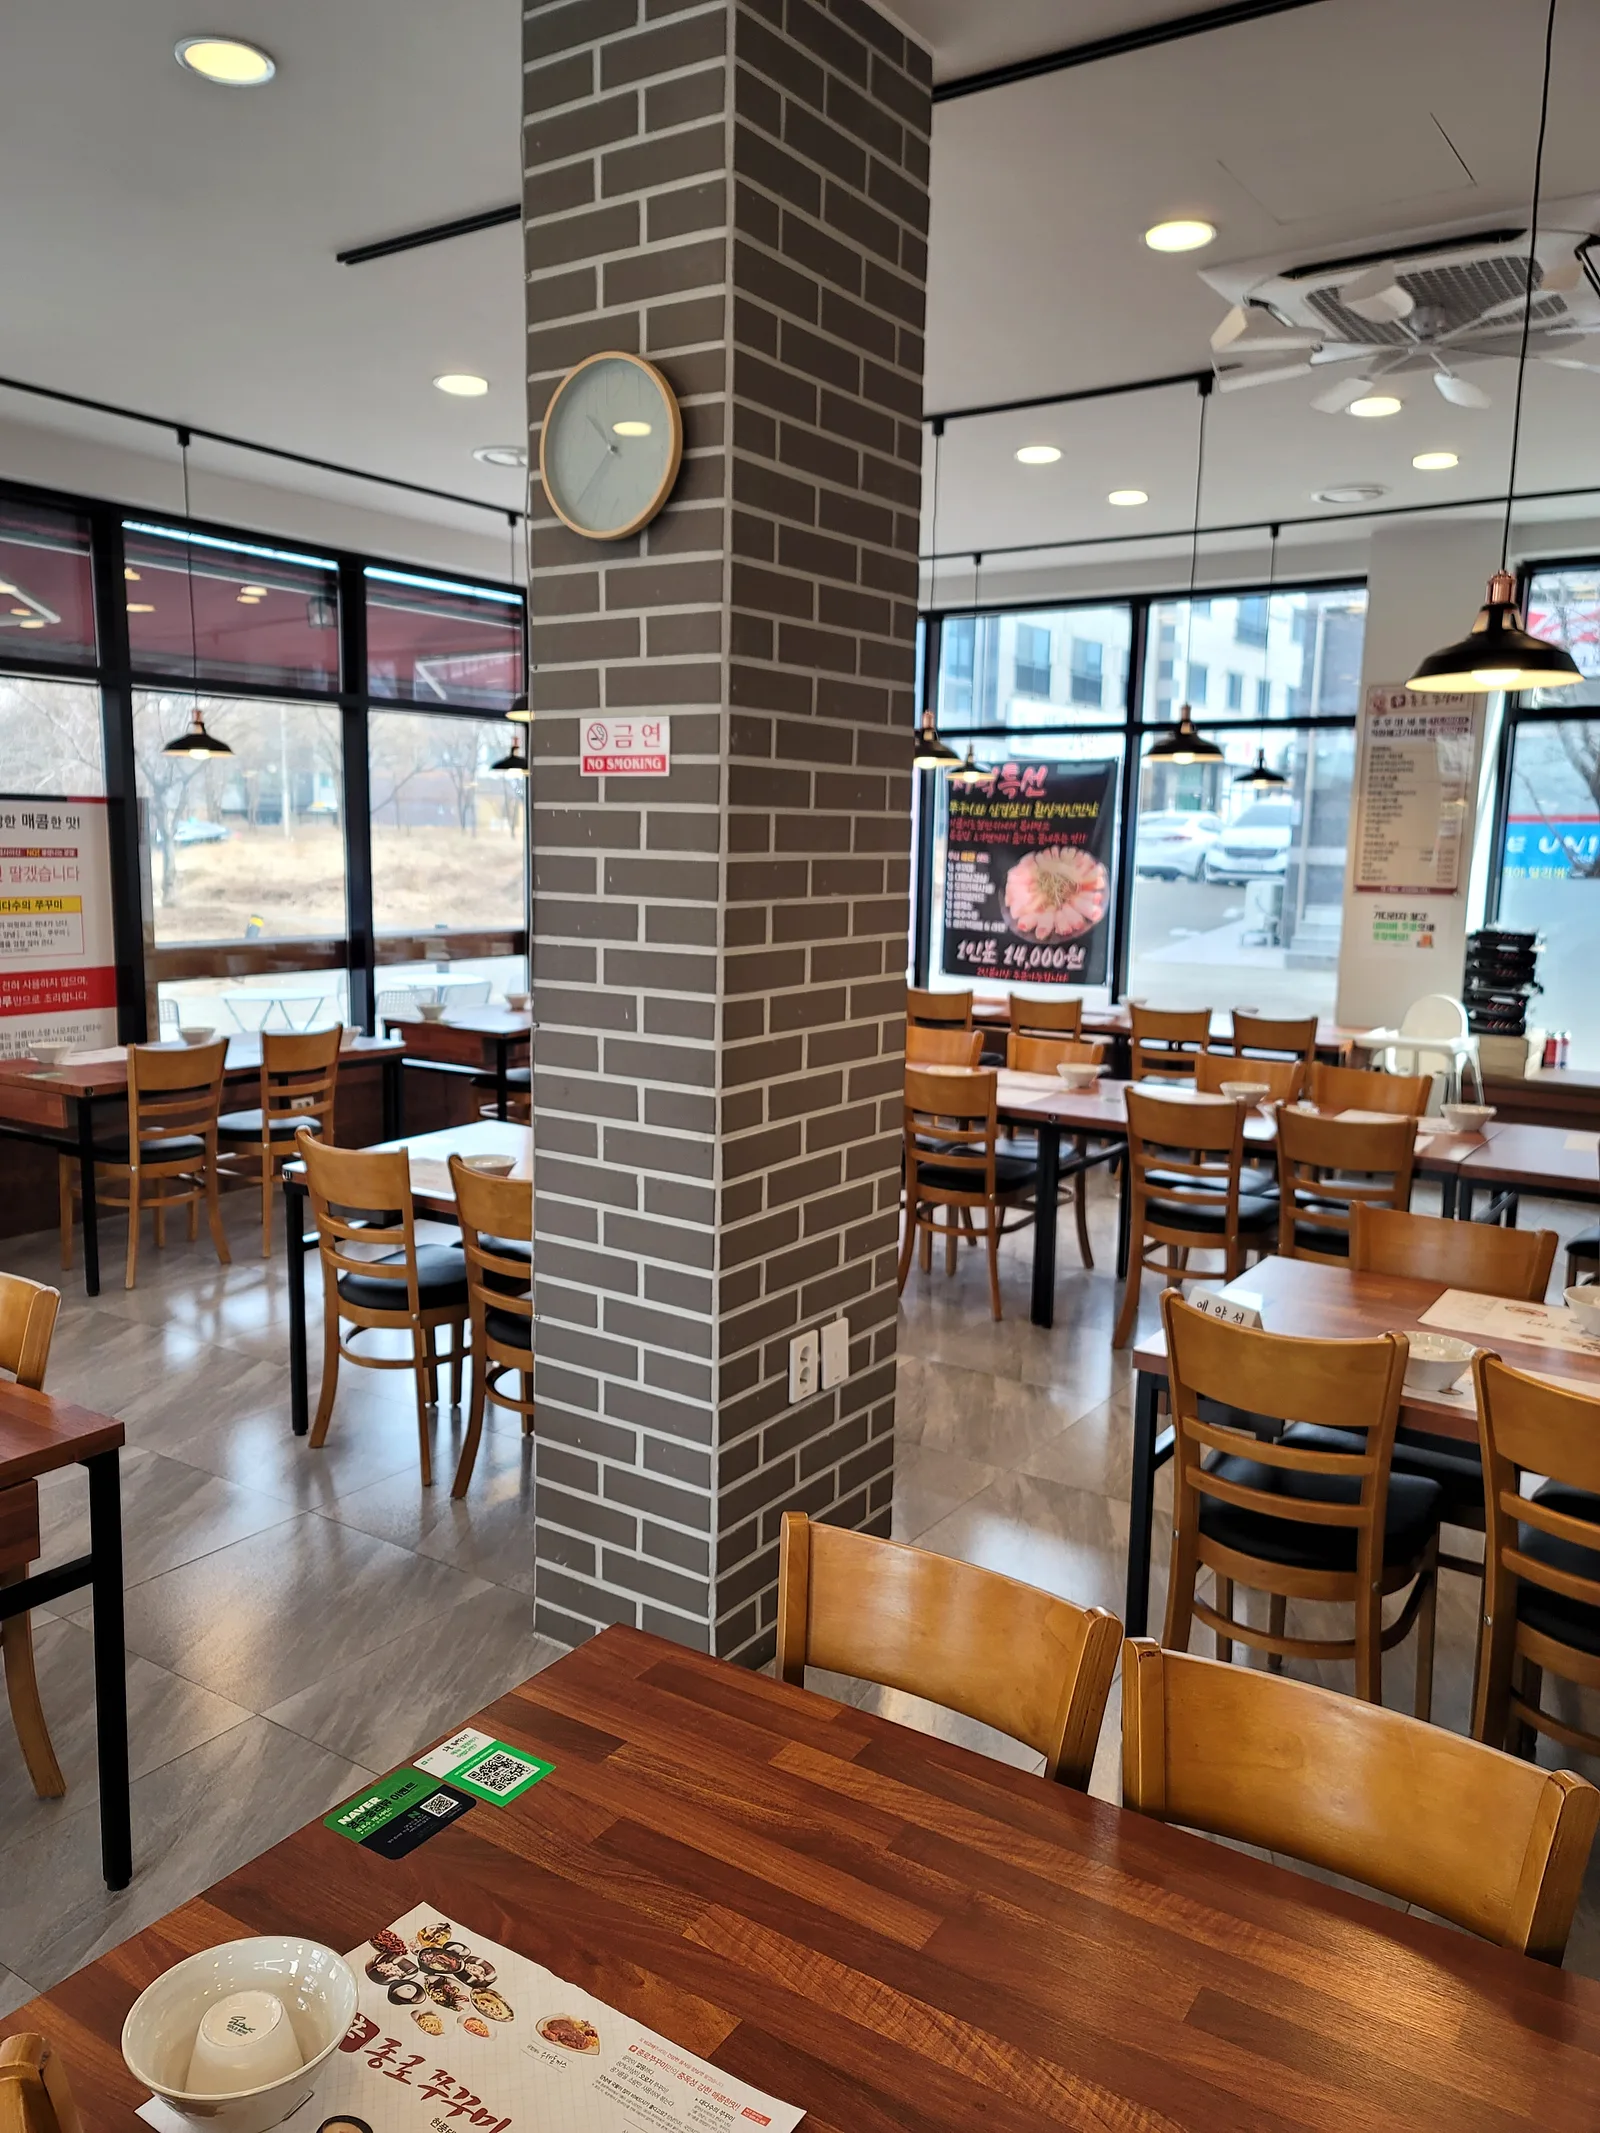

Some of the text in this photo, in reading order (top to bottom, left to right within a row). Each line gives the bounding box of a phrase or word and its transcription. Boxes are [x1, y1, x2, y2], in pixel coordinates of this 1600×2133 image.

[613, 722, 661, 748] 금연
[587, 756, 662, 771] NO SMOKING
[21, 812, 62, 831] 매콤한
[0, 899, 31, 912] 다수의
[956, 939, 1086, 971] 1인분 14,000원
[337, 1797, 382, 1825] NAVER
[346, 1799, 392, 1830] 영수증리뷰
[390, 1781, 418, 1801] 이벤트
[364, 2037, 513, 2133] 종로 쭈꾸미
[639, 2073, 655, 2086] 오로지
[676, 2071, 699, 2088] 중독성
[697, 2083, 713, 2096] 강한
[698, 2099, 720, 2114] 대다수의
